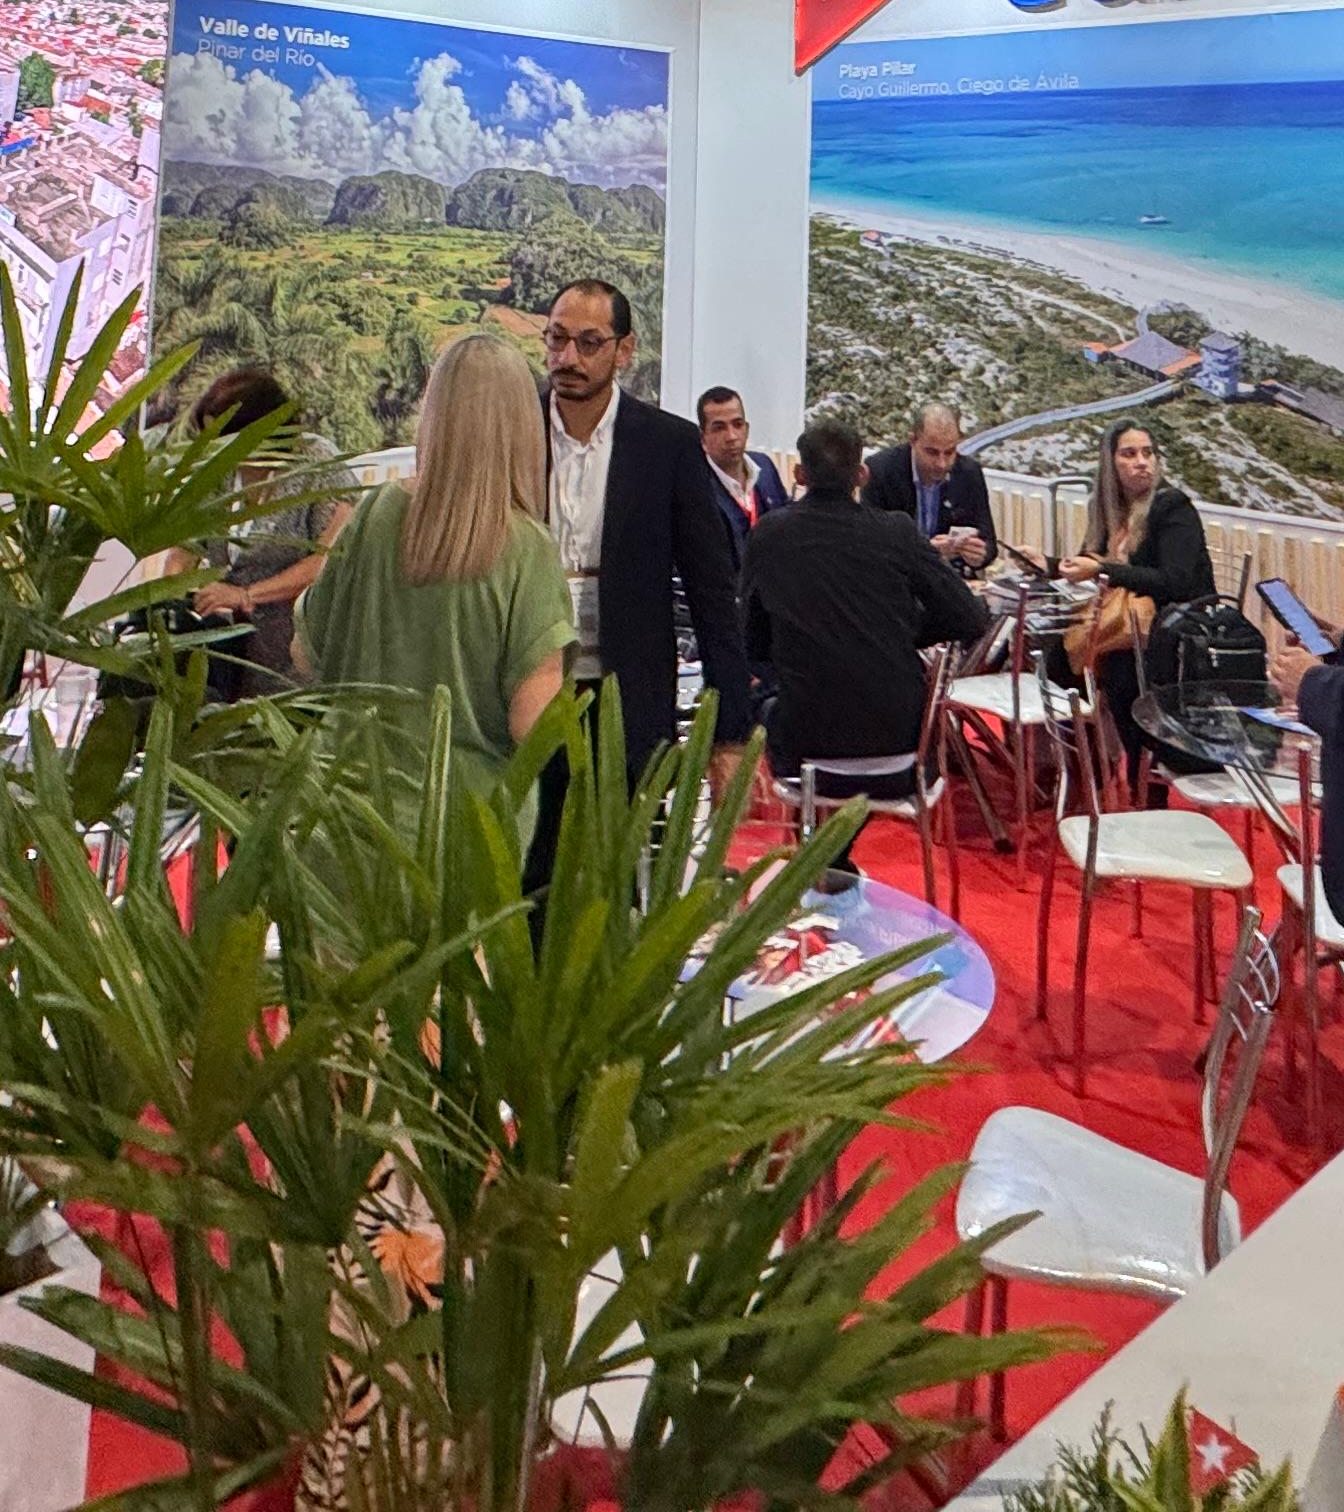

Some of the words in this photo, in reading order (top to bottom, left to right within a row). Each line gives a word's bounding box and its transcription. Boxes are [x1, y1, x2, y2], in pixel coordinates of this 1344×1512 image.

[199, 15, 250, 38] Valle
[253, 23, 280, 41] de
[283, 26, 350, 49] Viñales
[197, 39, 247, 59] Pinar
[251, 45, 281, 64] del
[839, 64, 878, 80] Playa
[882, 61, 917, 77] Pilar
[839, 83, 874, 101] Cayo
[958, 77, 1004, 95] Ciego
[1008, 74, 1030, 91] de
